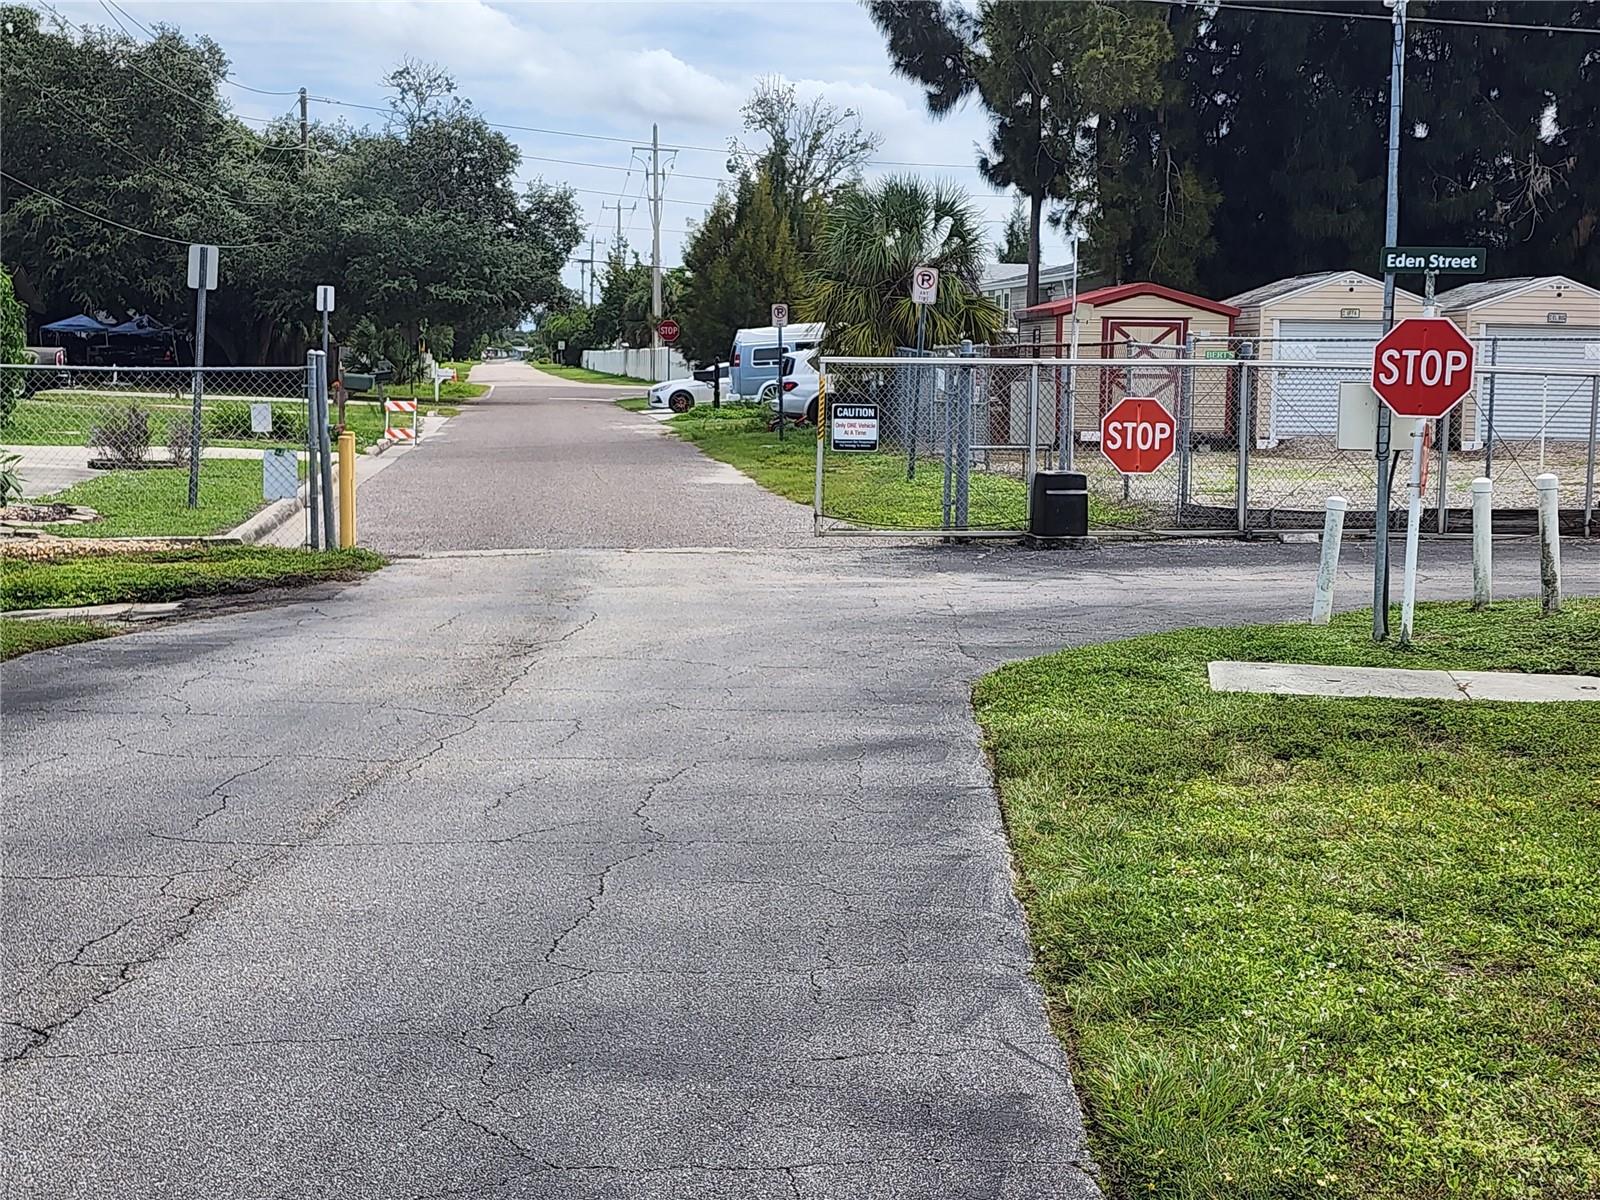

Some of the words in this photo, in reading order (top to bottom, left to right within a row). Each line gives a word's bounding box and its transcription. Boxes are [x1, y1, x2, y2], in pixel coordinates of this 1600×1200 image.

[1386, 253, 1425, 268] Eden
[1428, 254, 1477, 268] Street
[660, 326, 678, 335] STOP
[1378, 349, 1468, 386] STOP
[837, 407, 874, 417] CAUTION
[1106, 421, 1171, 450] STOP
